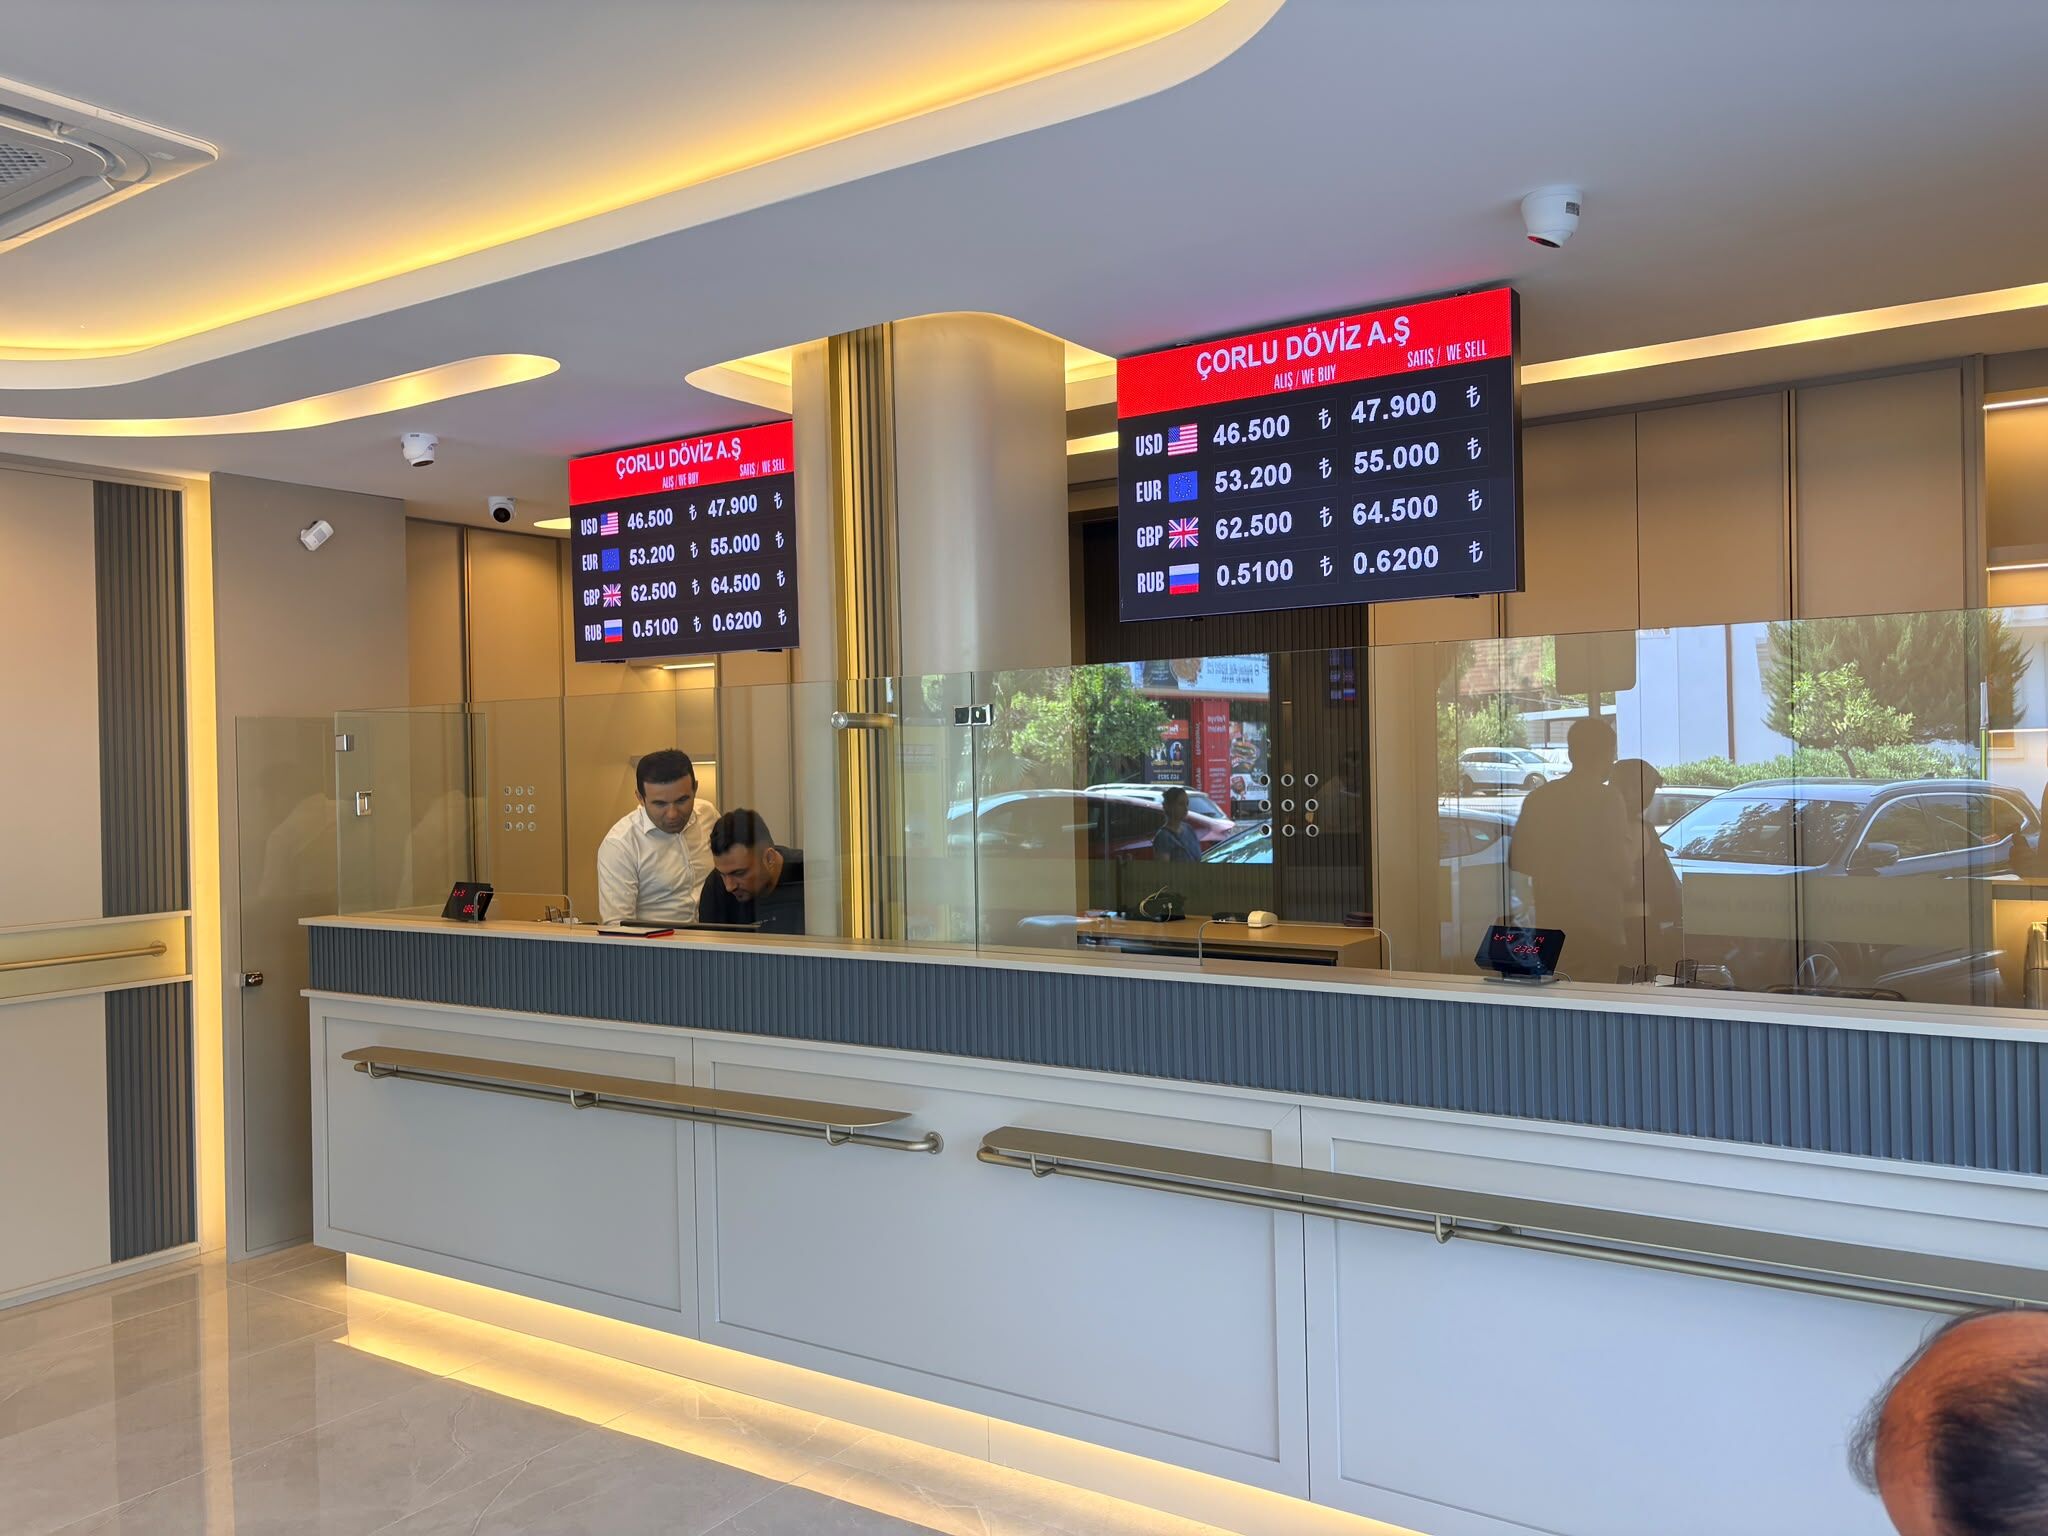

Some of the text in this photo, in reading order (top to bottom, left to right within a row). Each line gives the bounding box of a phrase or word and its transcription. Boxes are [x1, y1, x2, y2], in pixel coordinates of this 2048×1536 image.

[1196, 316, 1409, 381] ÇORLU DÖVİZ A.Ş
[1408, 348, 1434, 367] SATIŞ
[1447, 344, 1461, 361] WE
[1465, 340, 1486, 358] SELL
[1274, 372, 1292, 390] ALIŞ
[1302, 368, 1314, 384] WE
[1318, 365, 1335, 382] BUY
[1136, 433, 1162, 456] USD
[1213, 415, 1289, 445] 46.500
[1351, 391, 1436, 423] 47.900
[616, 438, 741, 480] ÇORLU DÖVİZ A.Ş
[1136, 480, 1161, 502] EUR
[1215, 463, 1291, 492] 53.200
[1354, 442, 1439, 474] 55.000
[581, 518, 597, 535] USD
[628, 508, 673, 529] 46.500
[708, 495, 757, 517] 47.900
[1137, 526, 1163, 548] GBP
[1216, 511, 1292, 539] 62.500
[1353, 495, 1437, 525] 64.500
[582, 554, 598, 571] EUR
[630, 544, 675, 565] 53.200
[711, 533, 760, 555] 55.000
[1138, 571, 1164, 593] RUB
[1217, 559, 1293, 586] 0.5100
[1354, 545, 1438, 574] 0.6200
[584, 589, 600, 606] GBP
[631, 581, 676, 602] 62.500
[711, 573, 760, 594] 64.500
[585, 624, 601, 641] RUB
[633, 618, 678, 637] 0.5100
[713, 611, 761, 631] 0.6200
[1513, 945, 1540, 954] 2325
